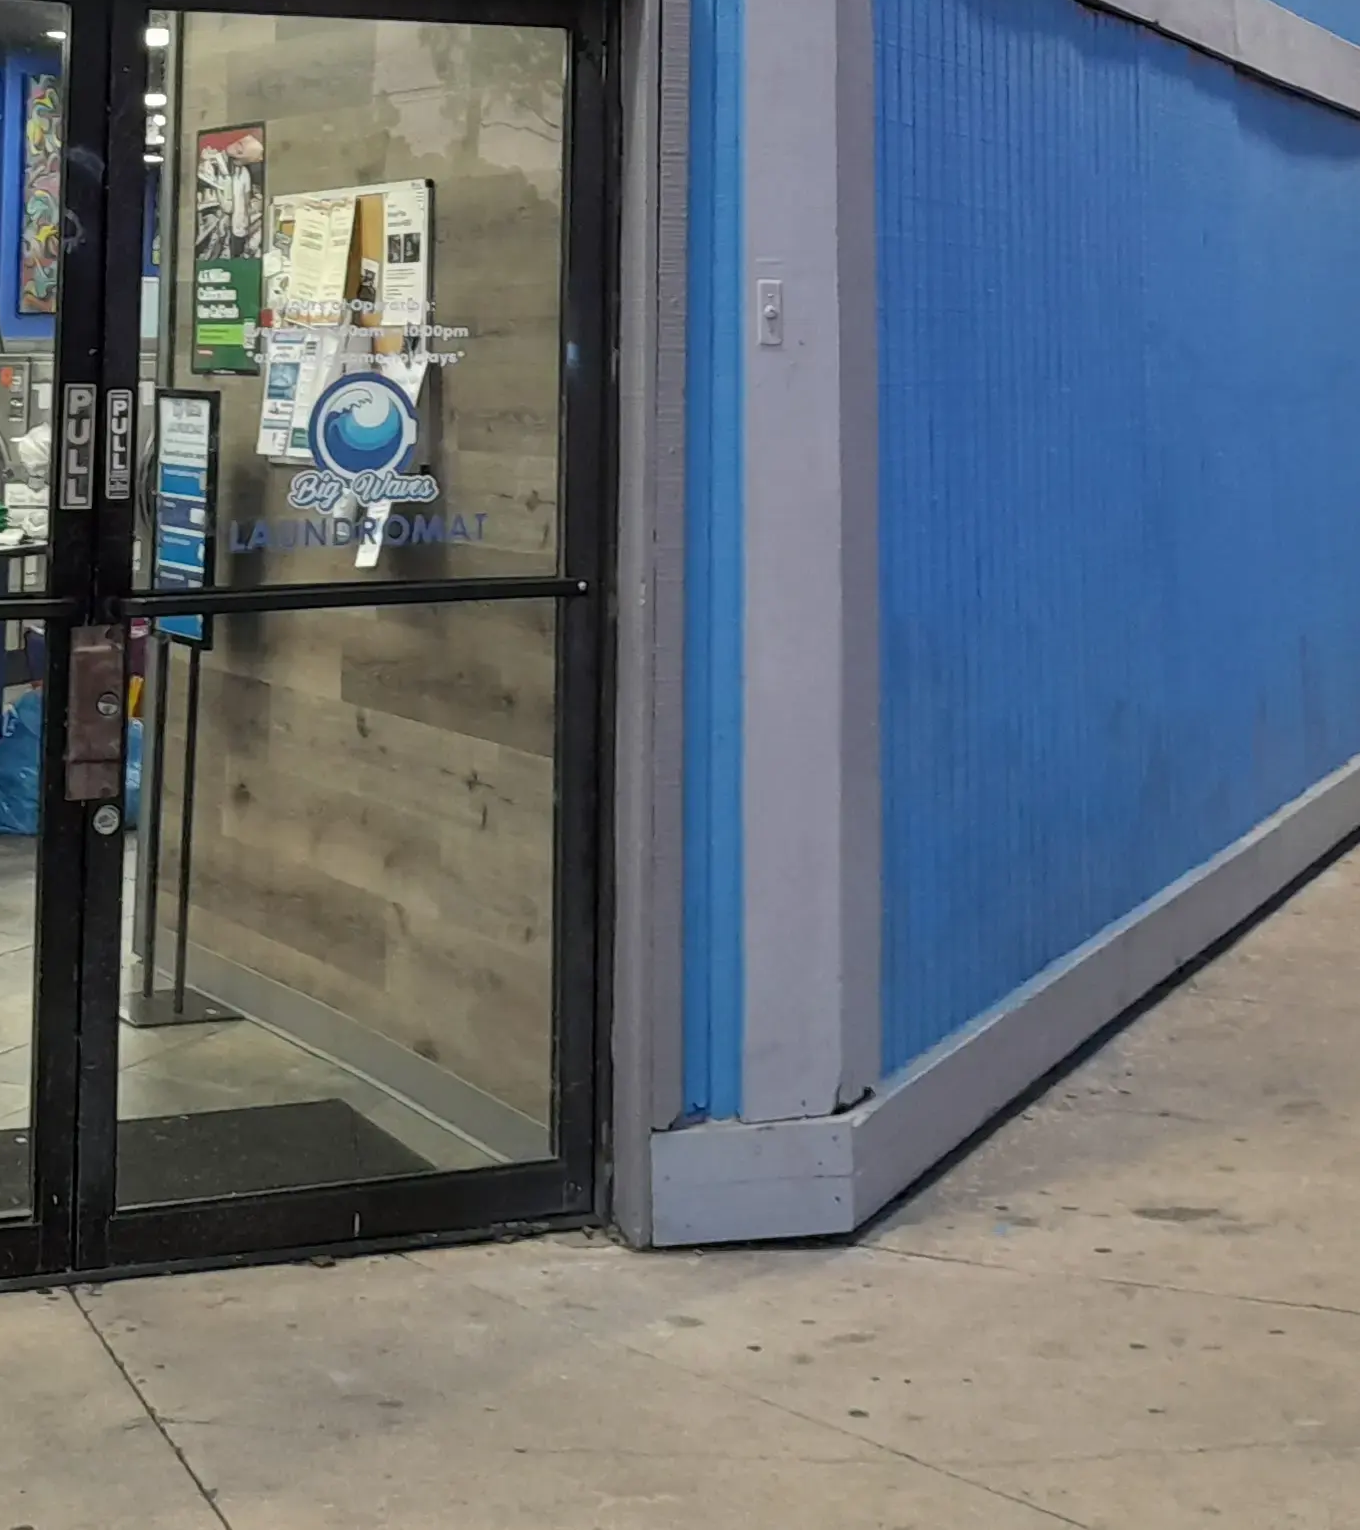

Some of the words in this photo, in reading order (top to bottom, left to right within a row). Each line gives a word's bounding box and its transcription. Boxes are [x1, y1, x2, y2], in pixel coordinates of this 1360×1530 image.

[67, 388, 91, 504] PULL
[111, 399, 129, 469] PULL
[289, 471, 341, 513] Big
[352, 470, 439, 506] Waves
[229, 513, 488, 552] LAUNDROMAT
